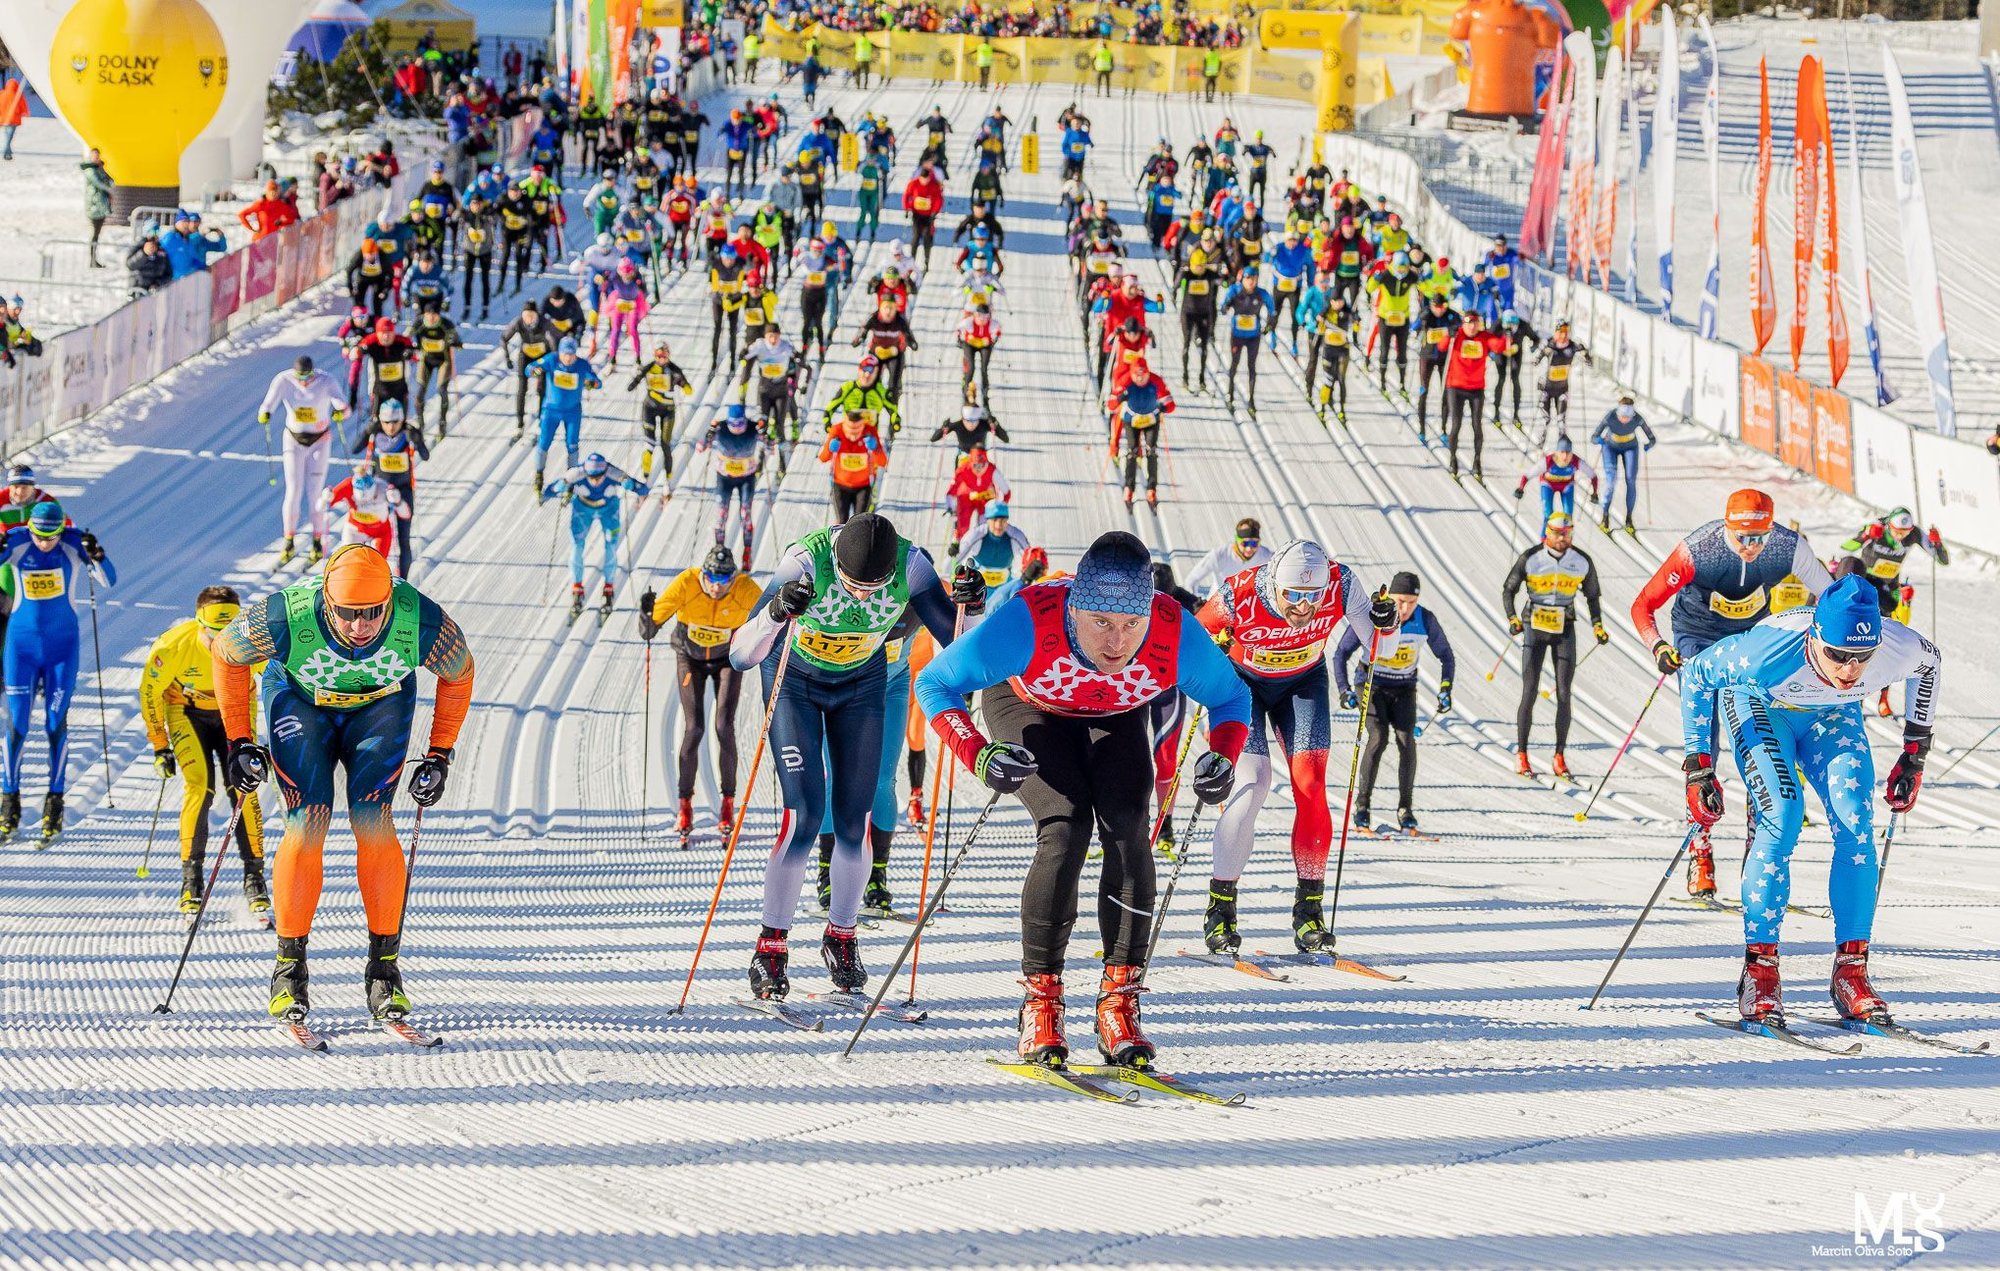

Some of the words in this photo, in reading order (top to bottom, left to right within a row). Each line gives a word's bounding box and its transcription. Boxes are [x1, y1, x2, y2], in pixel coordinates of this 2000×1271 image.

[99, 54, 159, 70] DOLNY
[804, 635, 861, 655] 1177
[1255, 652, 1309, 664] 1028
